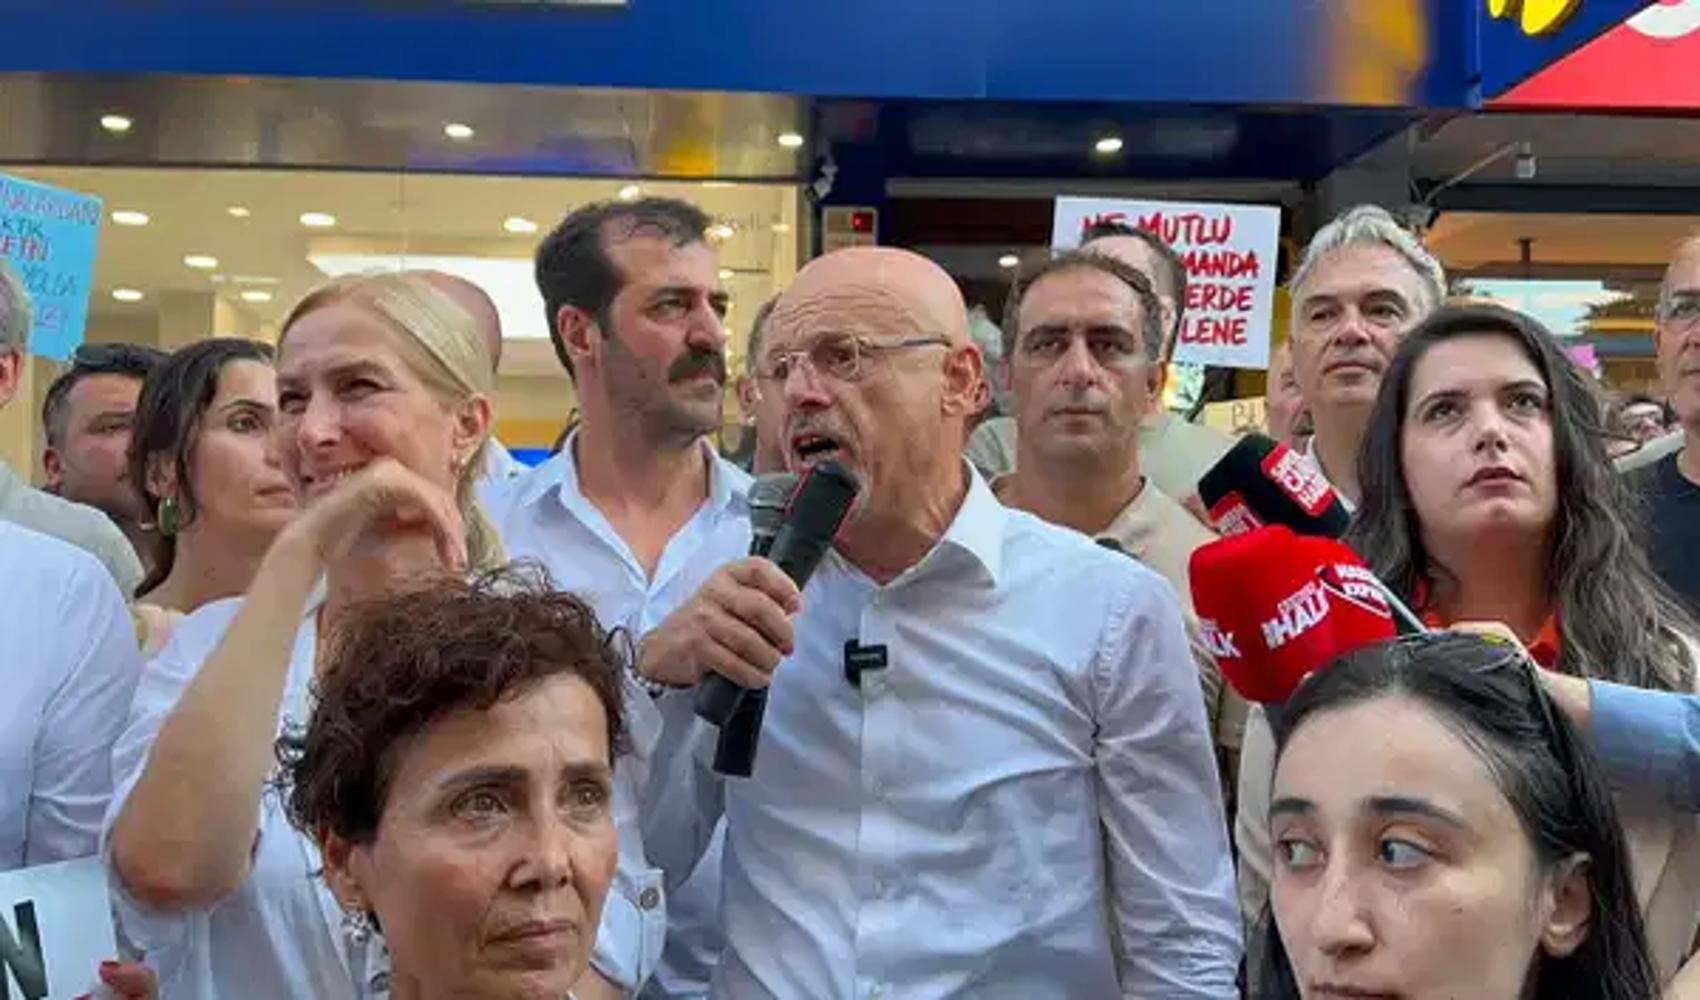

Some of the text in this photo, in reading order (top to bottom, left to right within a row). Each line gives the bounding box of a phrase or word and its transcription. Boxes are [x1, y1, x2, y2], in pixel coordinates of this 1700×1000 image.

[1137, 212, 1231, 245] MUTLU
[1184, 284, 1253, 311] ERDE
[1181, 317, 1248, 345] LENE
